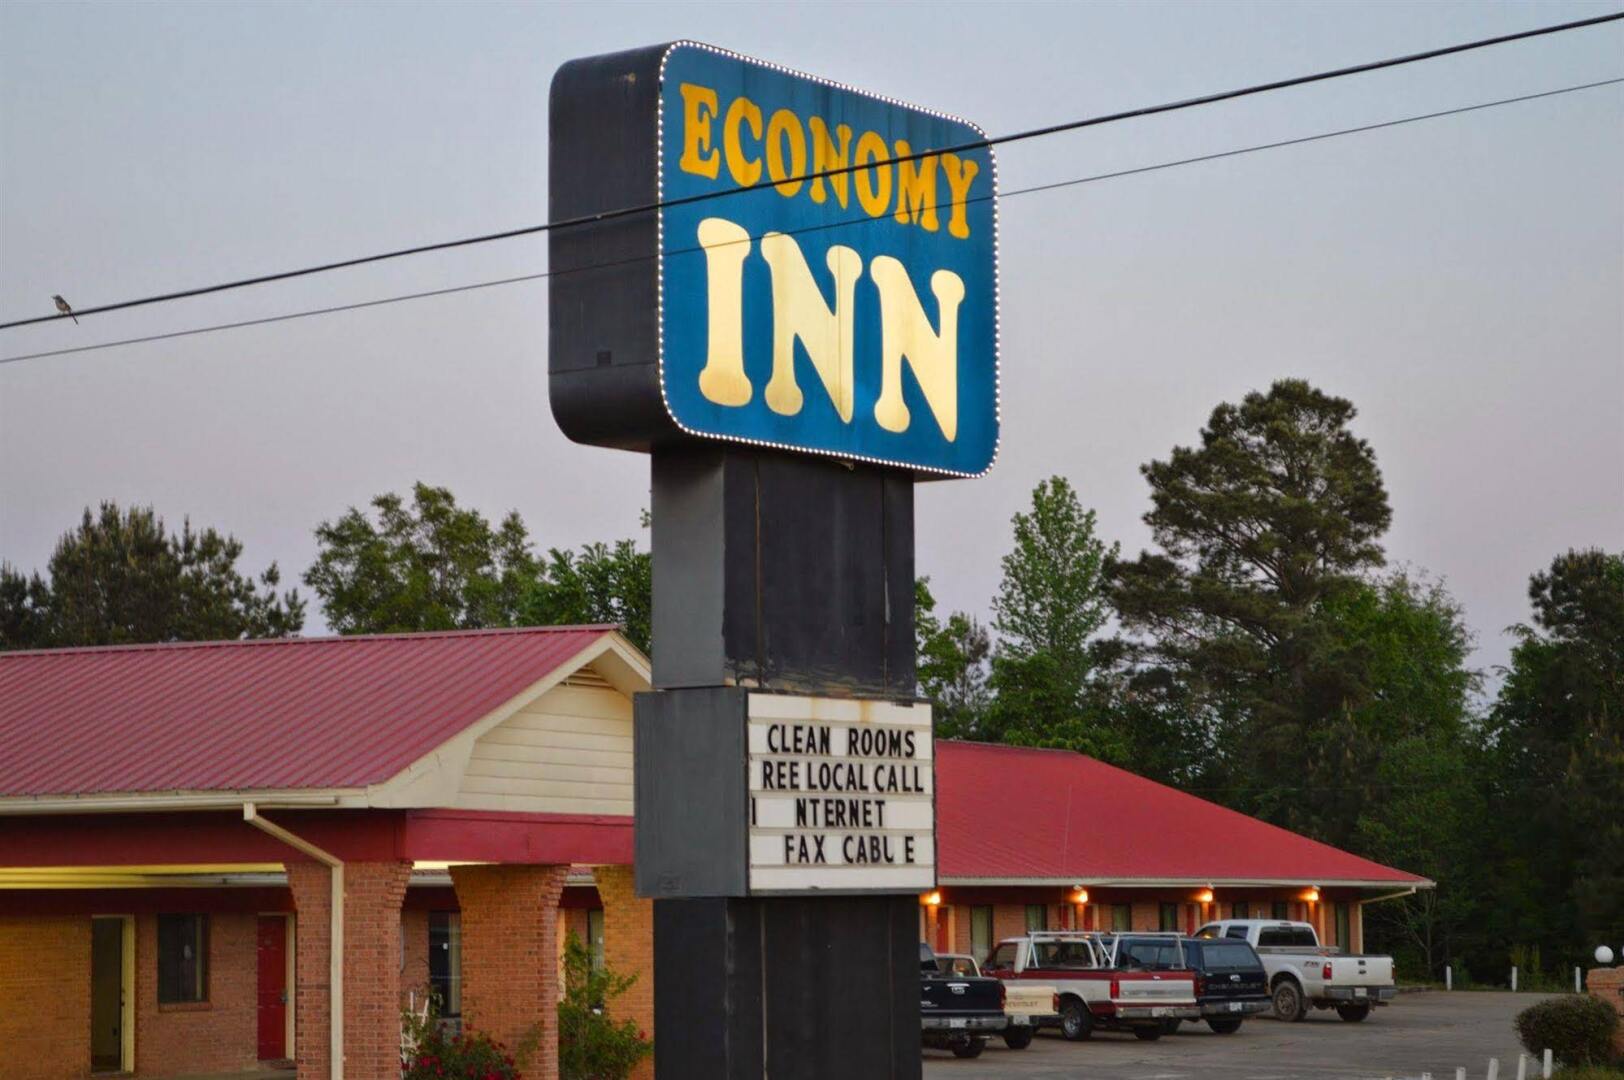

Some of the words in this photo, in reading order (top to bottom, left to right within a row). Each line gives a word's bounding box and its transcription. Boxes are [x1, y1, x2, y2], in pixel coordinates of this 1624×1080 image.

[679, 82, 979, 240] ECONOMY
[697, 217, 966, 443] INN
[767, 723, 831, 755] CLEAN
[848, 728, 915, 758] ROOMS
[763, 760, 800, 790] REE
[807, 762, 868, 792] LOCAL
[874, 764, 925, 793] CALL
[784, 834, 826, 864] FAX
